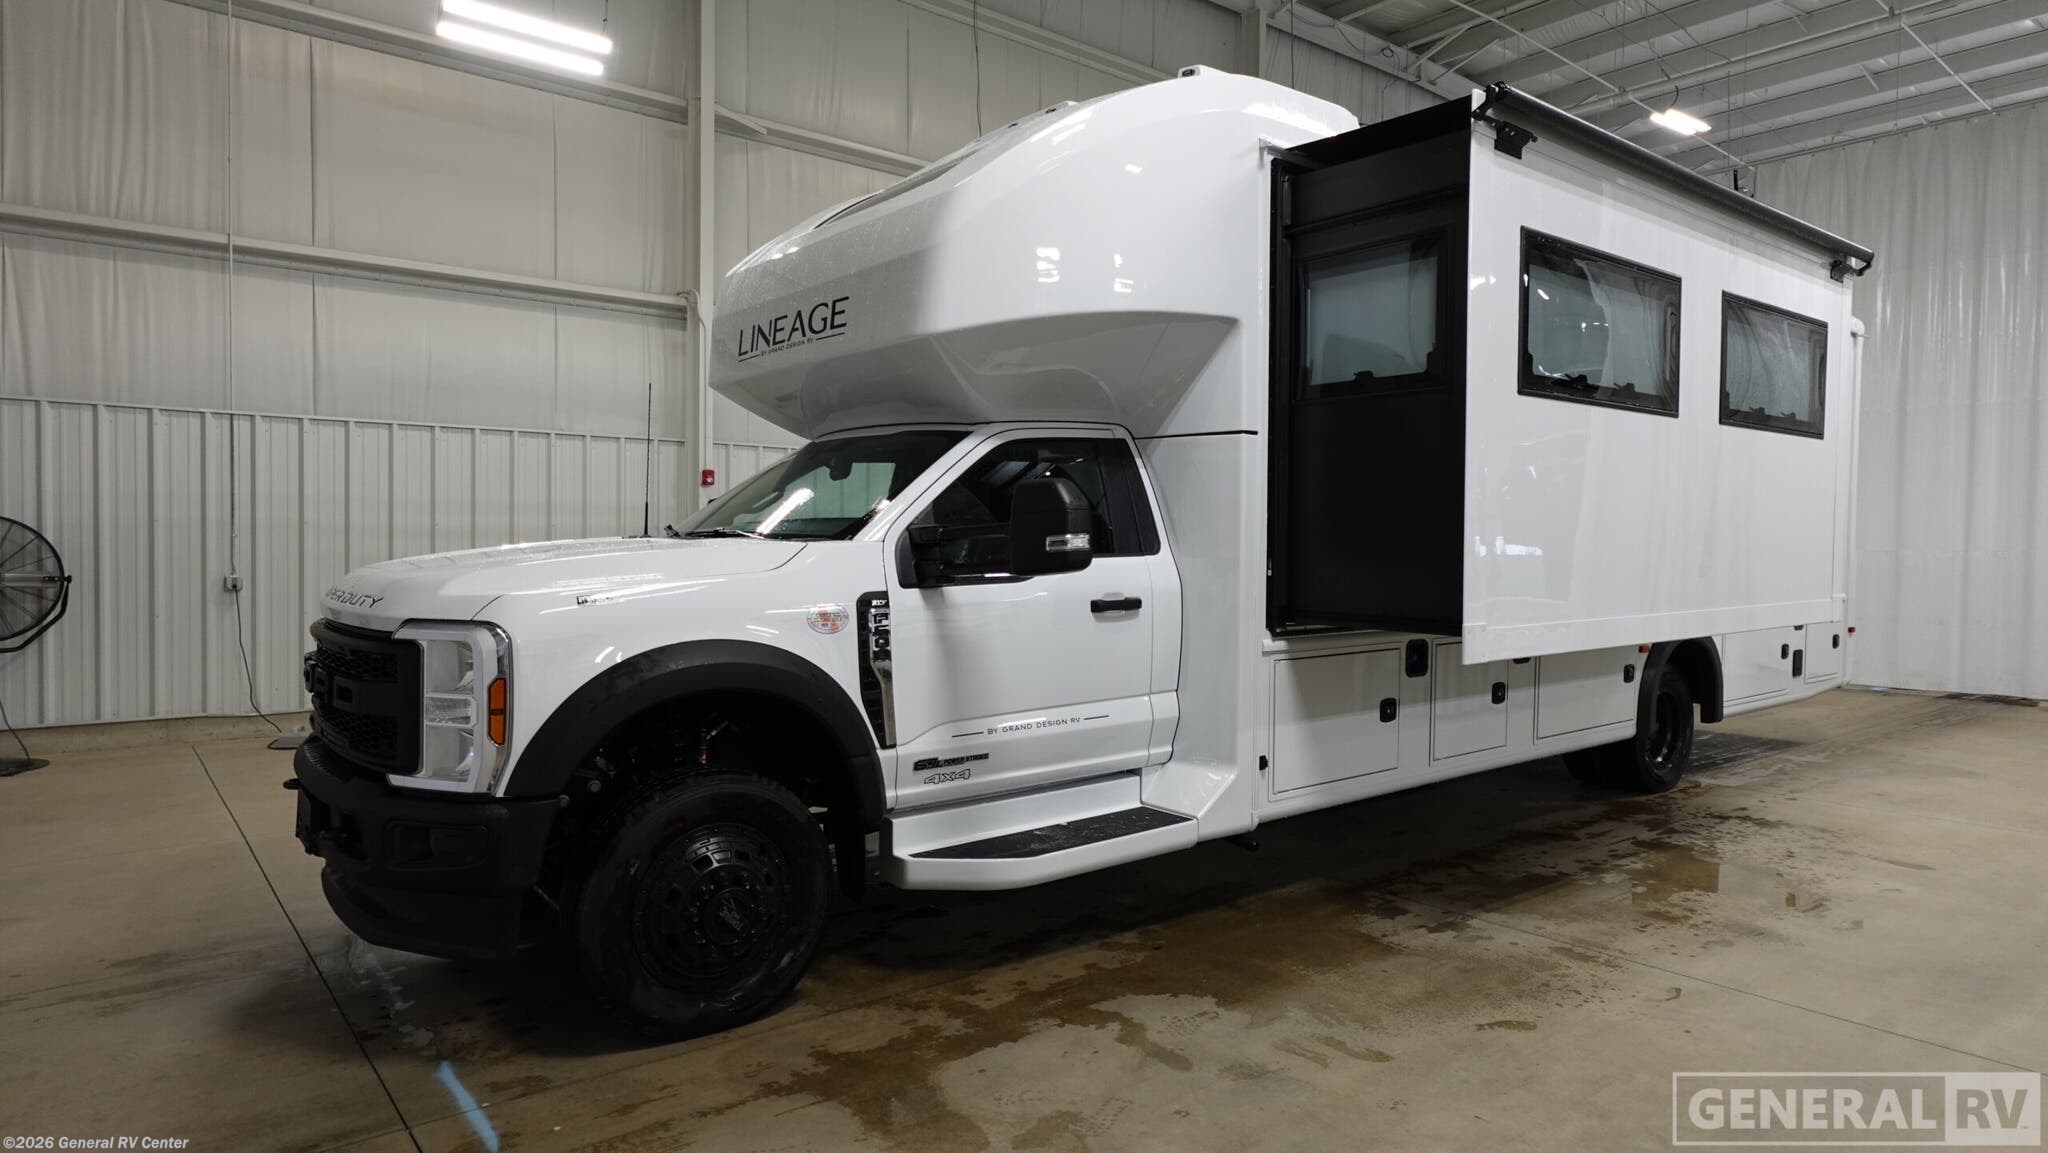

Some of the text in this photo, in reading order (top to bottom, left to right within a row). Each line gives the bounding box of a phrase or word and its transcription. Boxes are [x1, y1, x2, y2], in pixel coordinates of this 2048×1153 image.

[738, 296, 849, 357] LINEAGE
[786, 340, 806, 349] DESIGN
[340, 591, 384, 608] DUTY
[987, 717, 1081, 735] BY GRAND DESIGN RV
